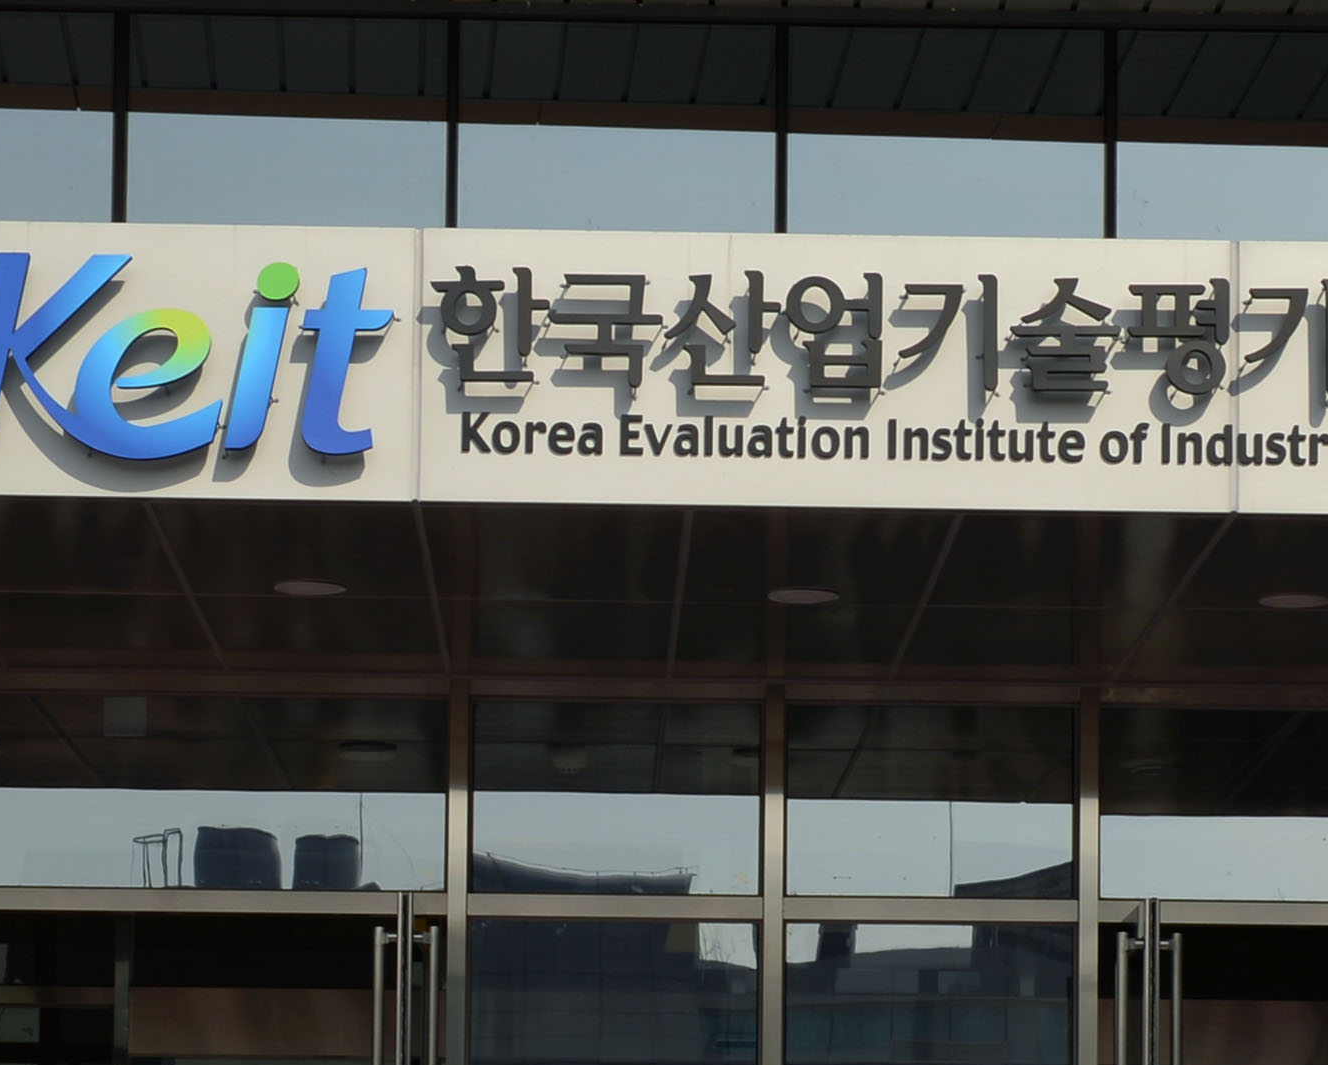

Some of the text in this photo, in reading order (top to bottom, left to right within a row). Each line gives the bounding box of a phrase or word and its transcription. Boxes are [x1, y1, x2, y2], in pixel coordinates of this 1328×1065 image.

[460, 411, 604, 455] Korea
[619, 414, 871, 460] Evaluation
[886, 418, 1086, 464] Institute
[1099, 422, 1150, 465] of
